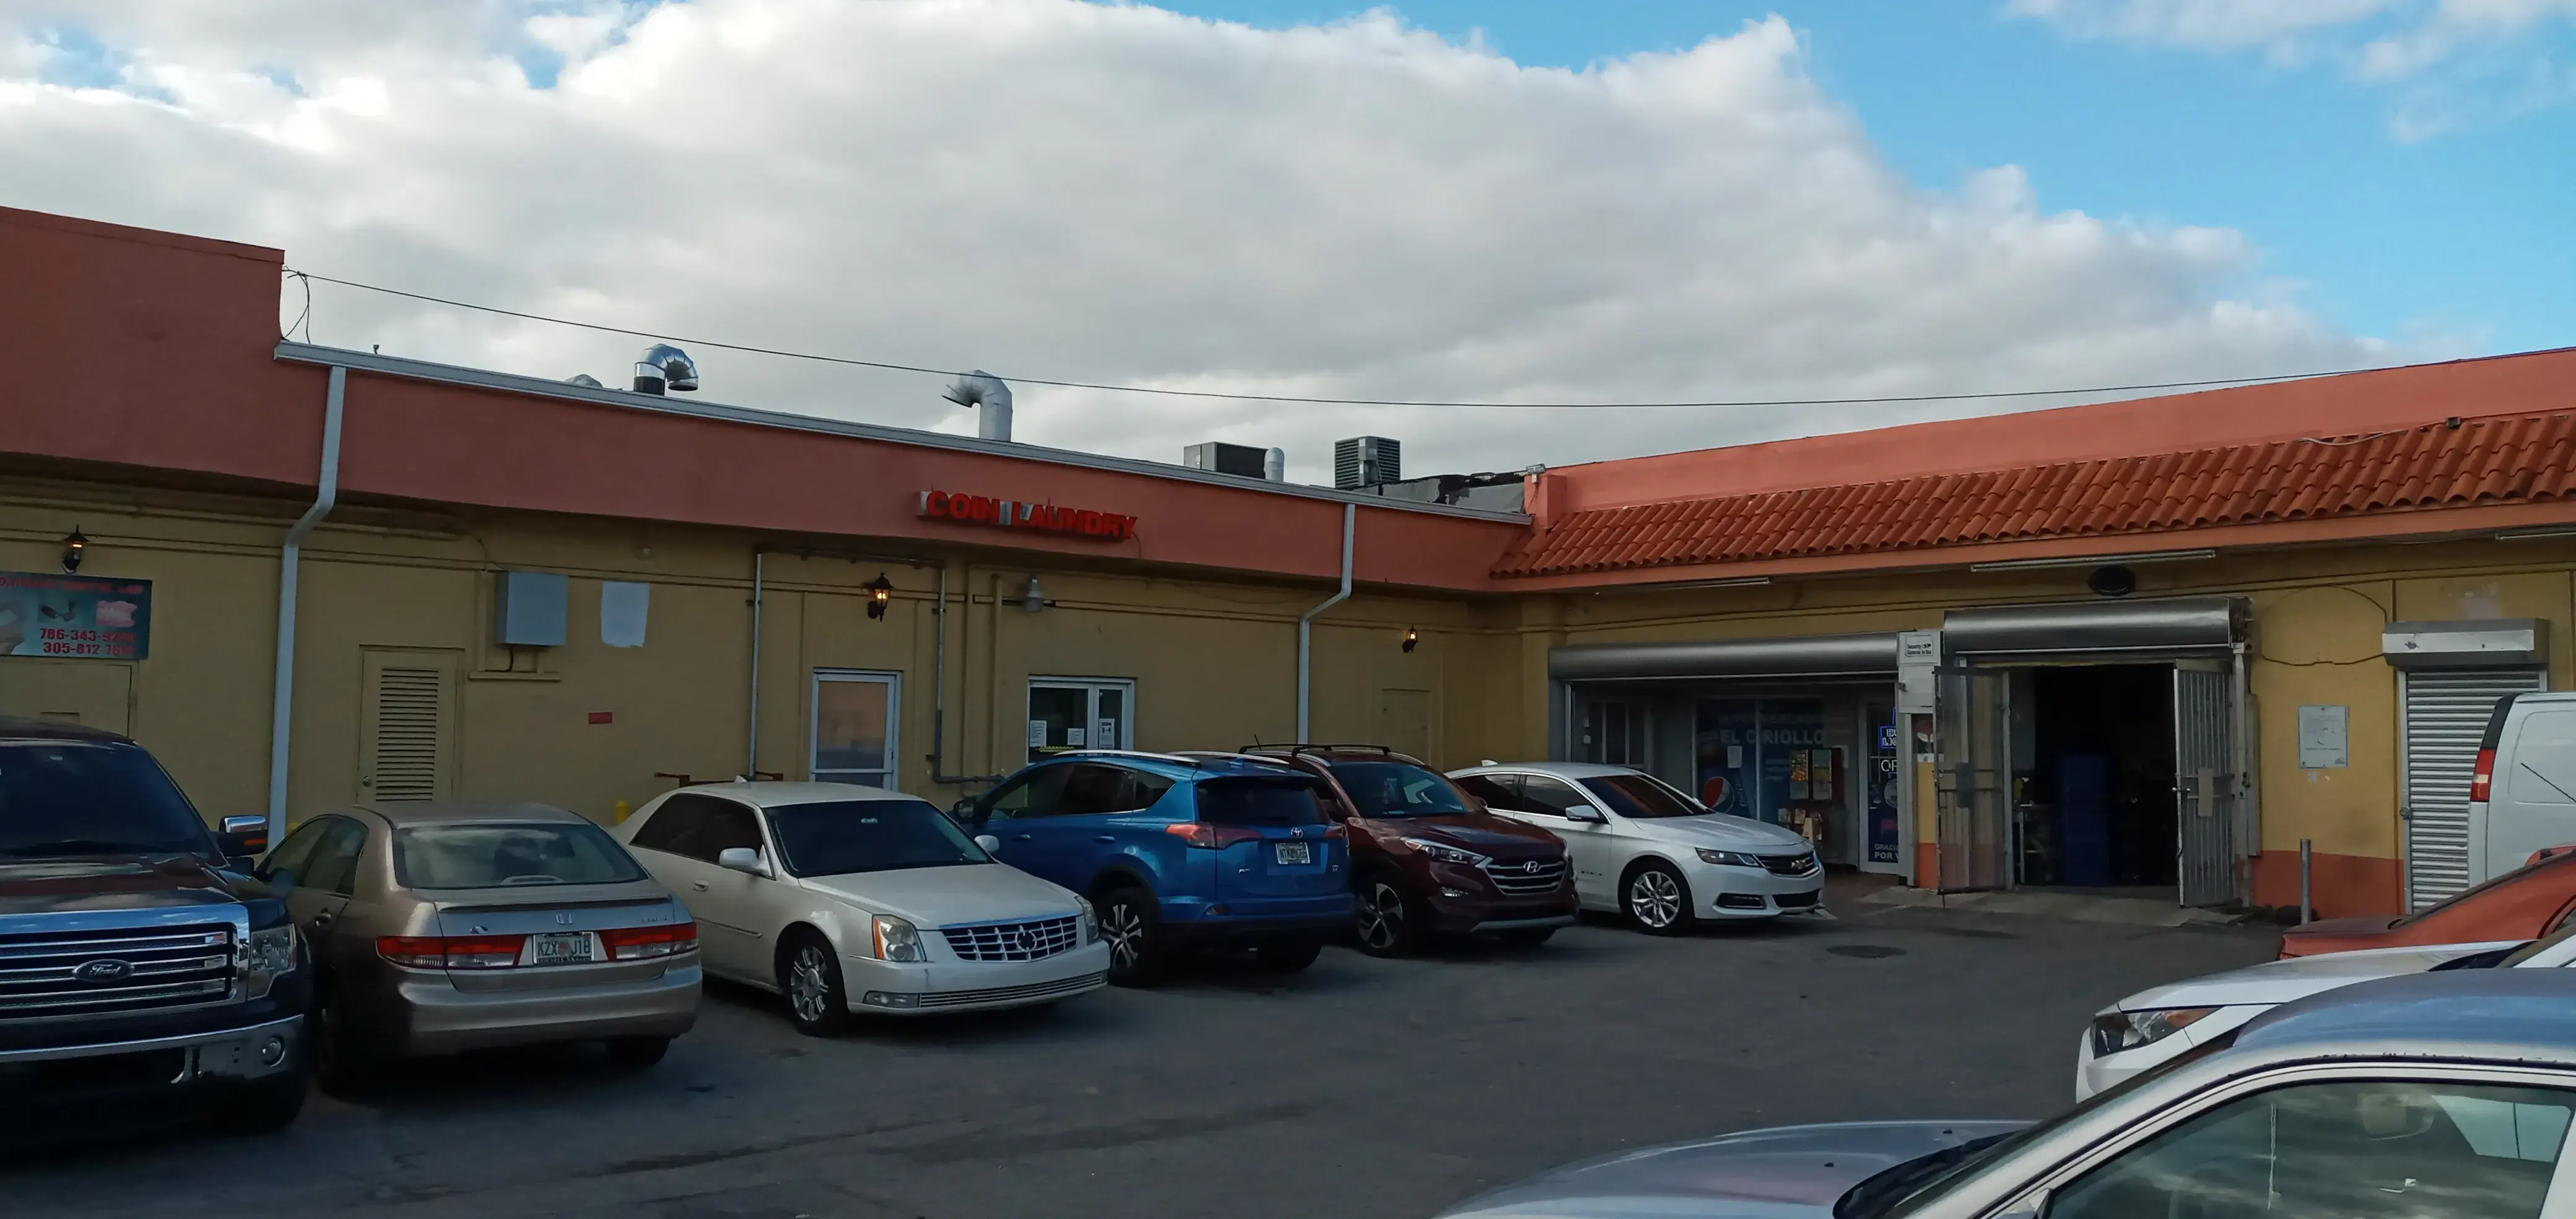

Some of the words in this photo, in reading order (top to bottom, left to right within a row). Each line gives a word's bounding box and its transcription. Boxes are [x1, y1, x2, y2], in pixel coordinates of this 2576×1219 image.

[921, 491, 1001, 524] COIN
[1011, 500, 1138, 539] LAUNDRY
[1720, 729, 1740, 745] EL
[1874, 851, 1894, 859] POR
[537, 940, 557, 956] KZX
[89, 964, 121, 976] Ford
